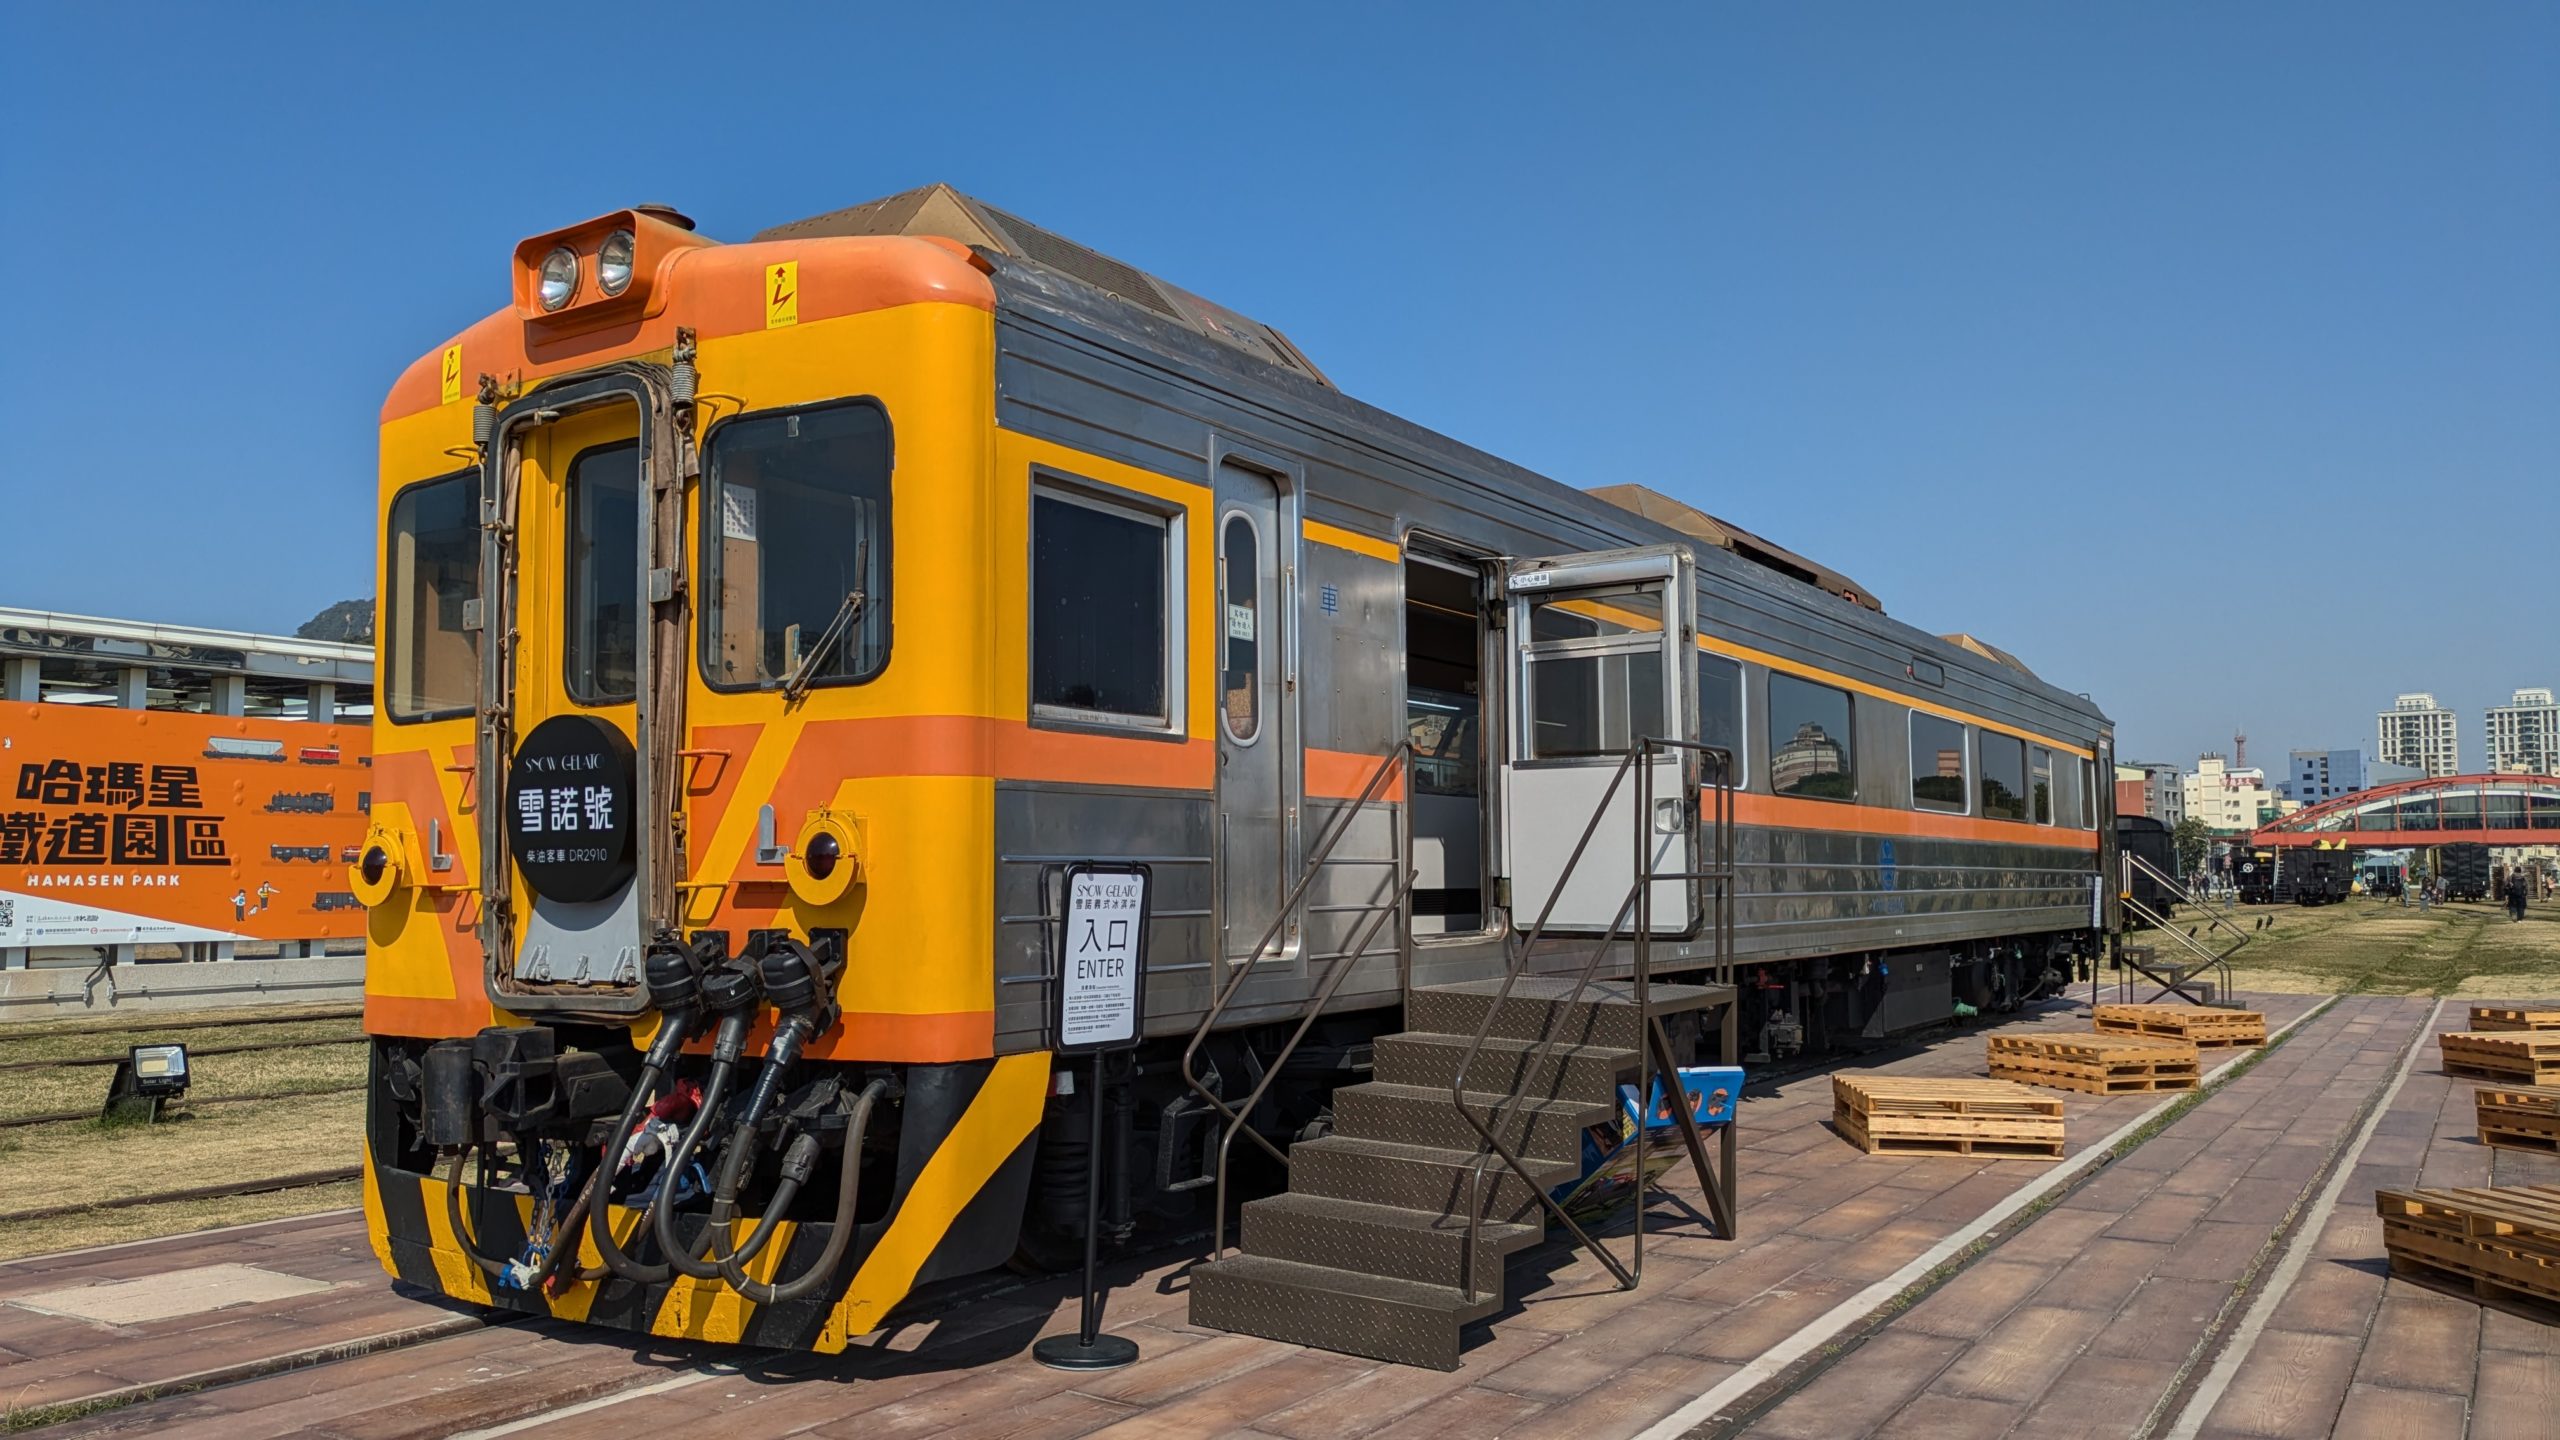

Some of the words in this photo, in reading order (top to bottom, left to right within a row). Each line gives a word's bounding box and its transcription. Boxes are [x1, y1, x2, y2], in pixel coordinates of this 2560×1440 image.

[1320, 583, 1338, 616] 車
[525, 756, 556, 773] SNOW
[561, 754, 604, 772] GELATO
[16, 759, 203, 811] 哈瑪星
[518, 785, 614, 832] 雪諾號
[0, 811, 231, 866] 鐵道園區
[527, 849, 566, 863] 柴油客車
[569, 848, 607, 862] DR2910
[27, 874, 125, 887] HAMASEN
[132, 874, 181, 887] PARK
[1077, 884, 1103, 898] SNOW
[1106, 884, 1137, 898] GELATO
[1079, 918, 1128, 953] 入口
[1077, 958, 1124, 979] ENTER
